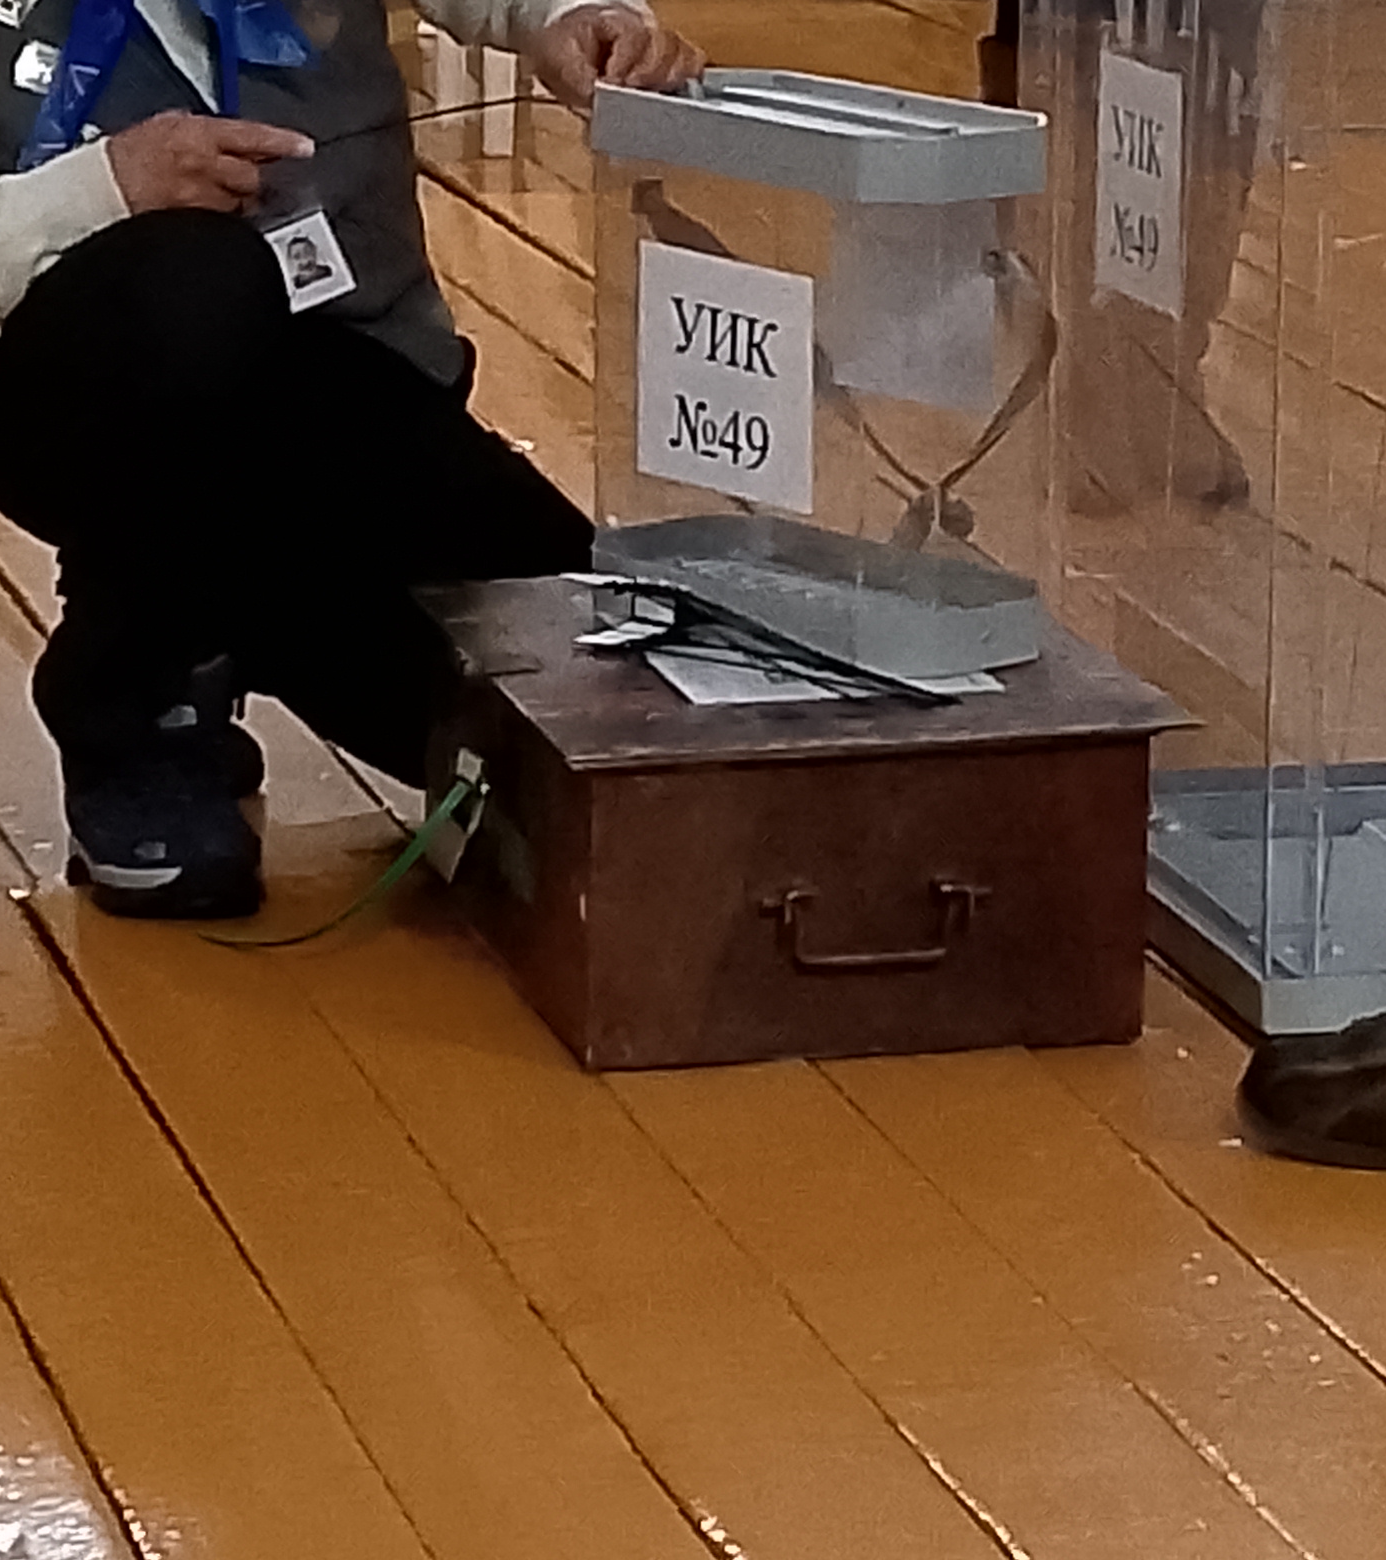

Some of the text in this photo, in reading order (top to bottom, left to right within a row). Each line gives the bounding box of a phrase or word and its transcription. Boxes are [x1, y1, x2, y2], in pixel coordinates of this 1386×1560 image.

[1110, 104, 1164, 179] УИК
[670, 295, 779, 379] УИК
[668, 393, 770, 471] №49
